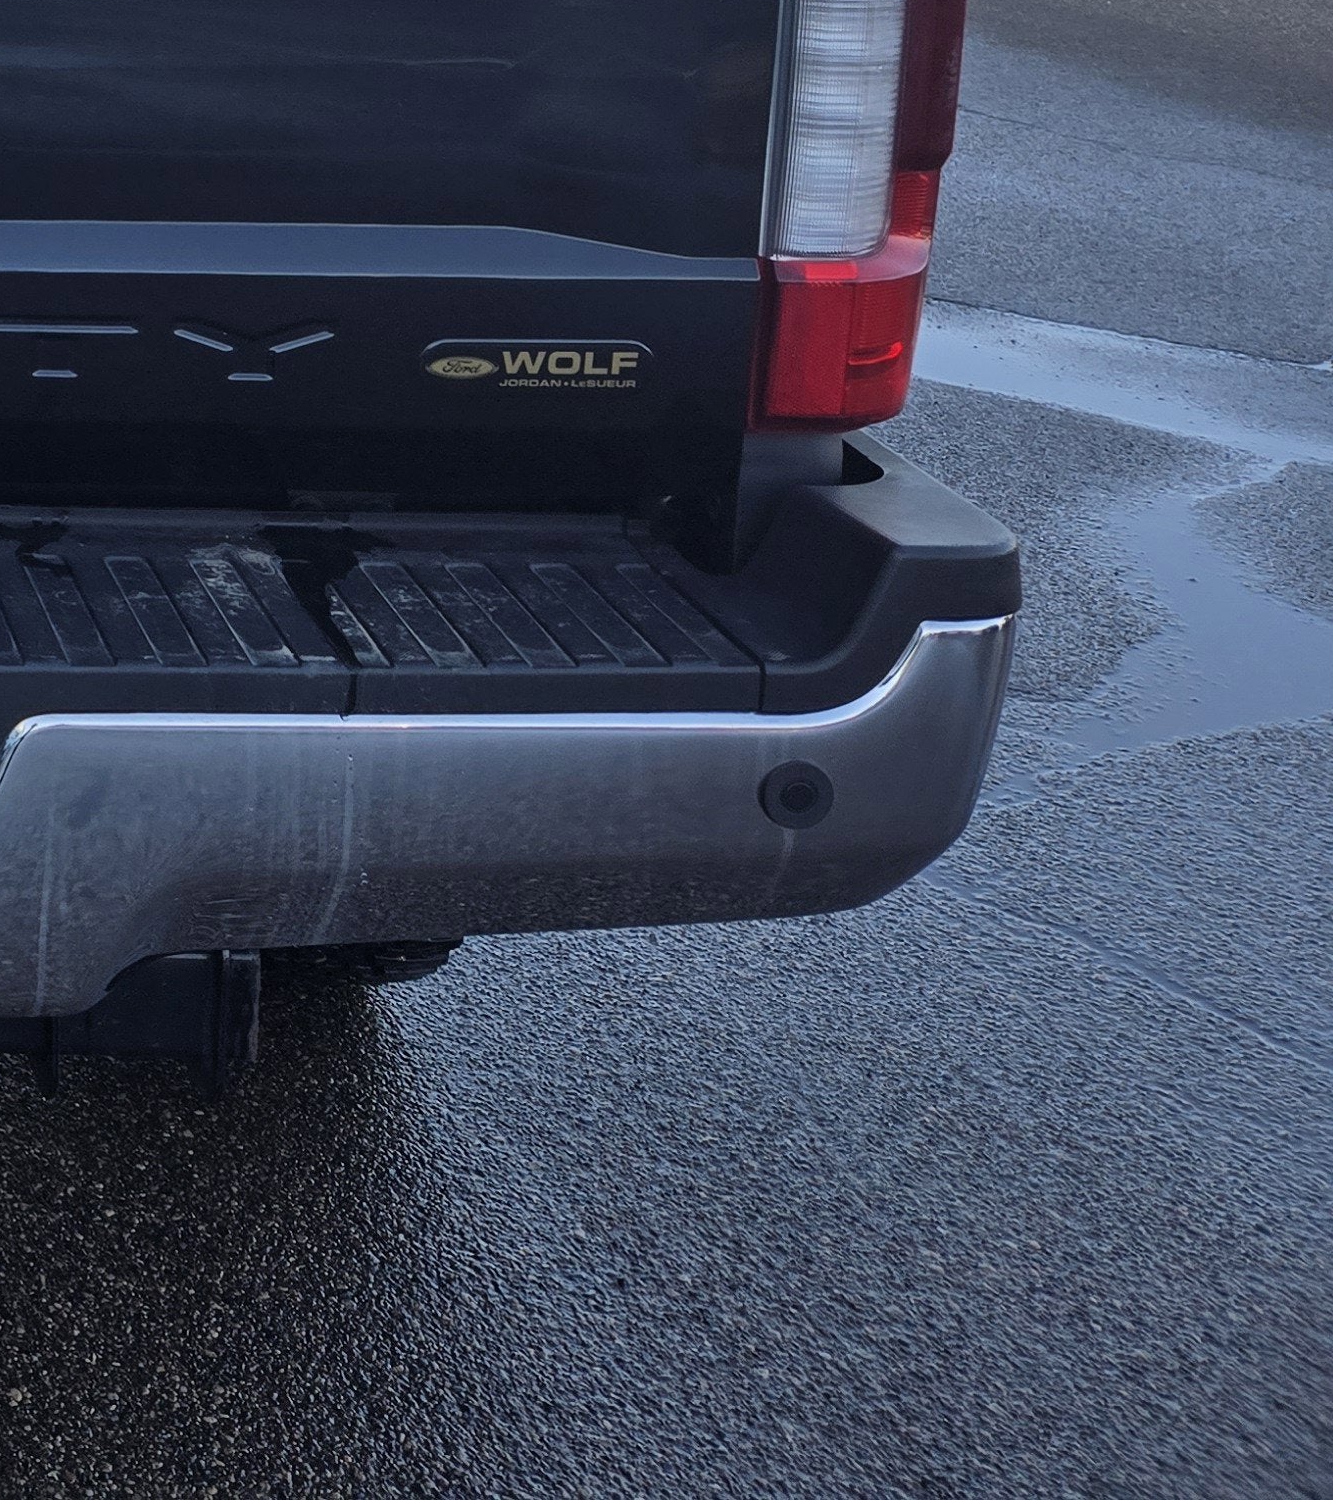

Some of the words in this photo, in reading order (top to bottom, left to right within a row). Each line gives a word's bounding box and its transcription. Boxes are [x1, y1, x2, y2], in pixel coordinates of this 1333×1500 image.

[442, 359, 483, 374] Ford
[502, 351, 639, 375] WOLF
[499, 378, 562, 387] JORDAN
